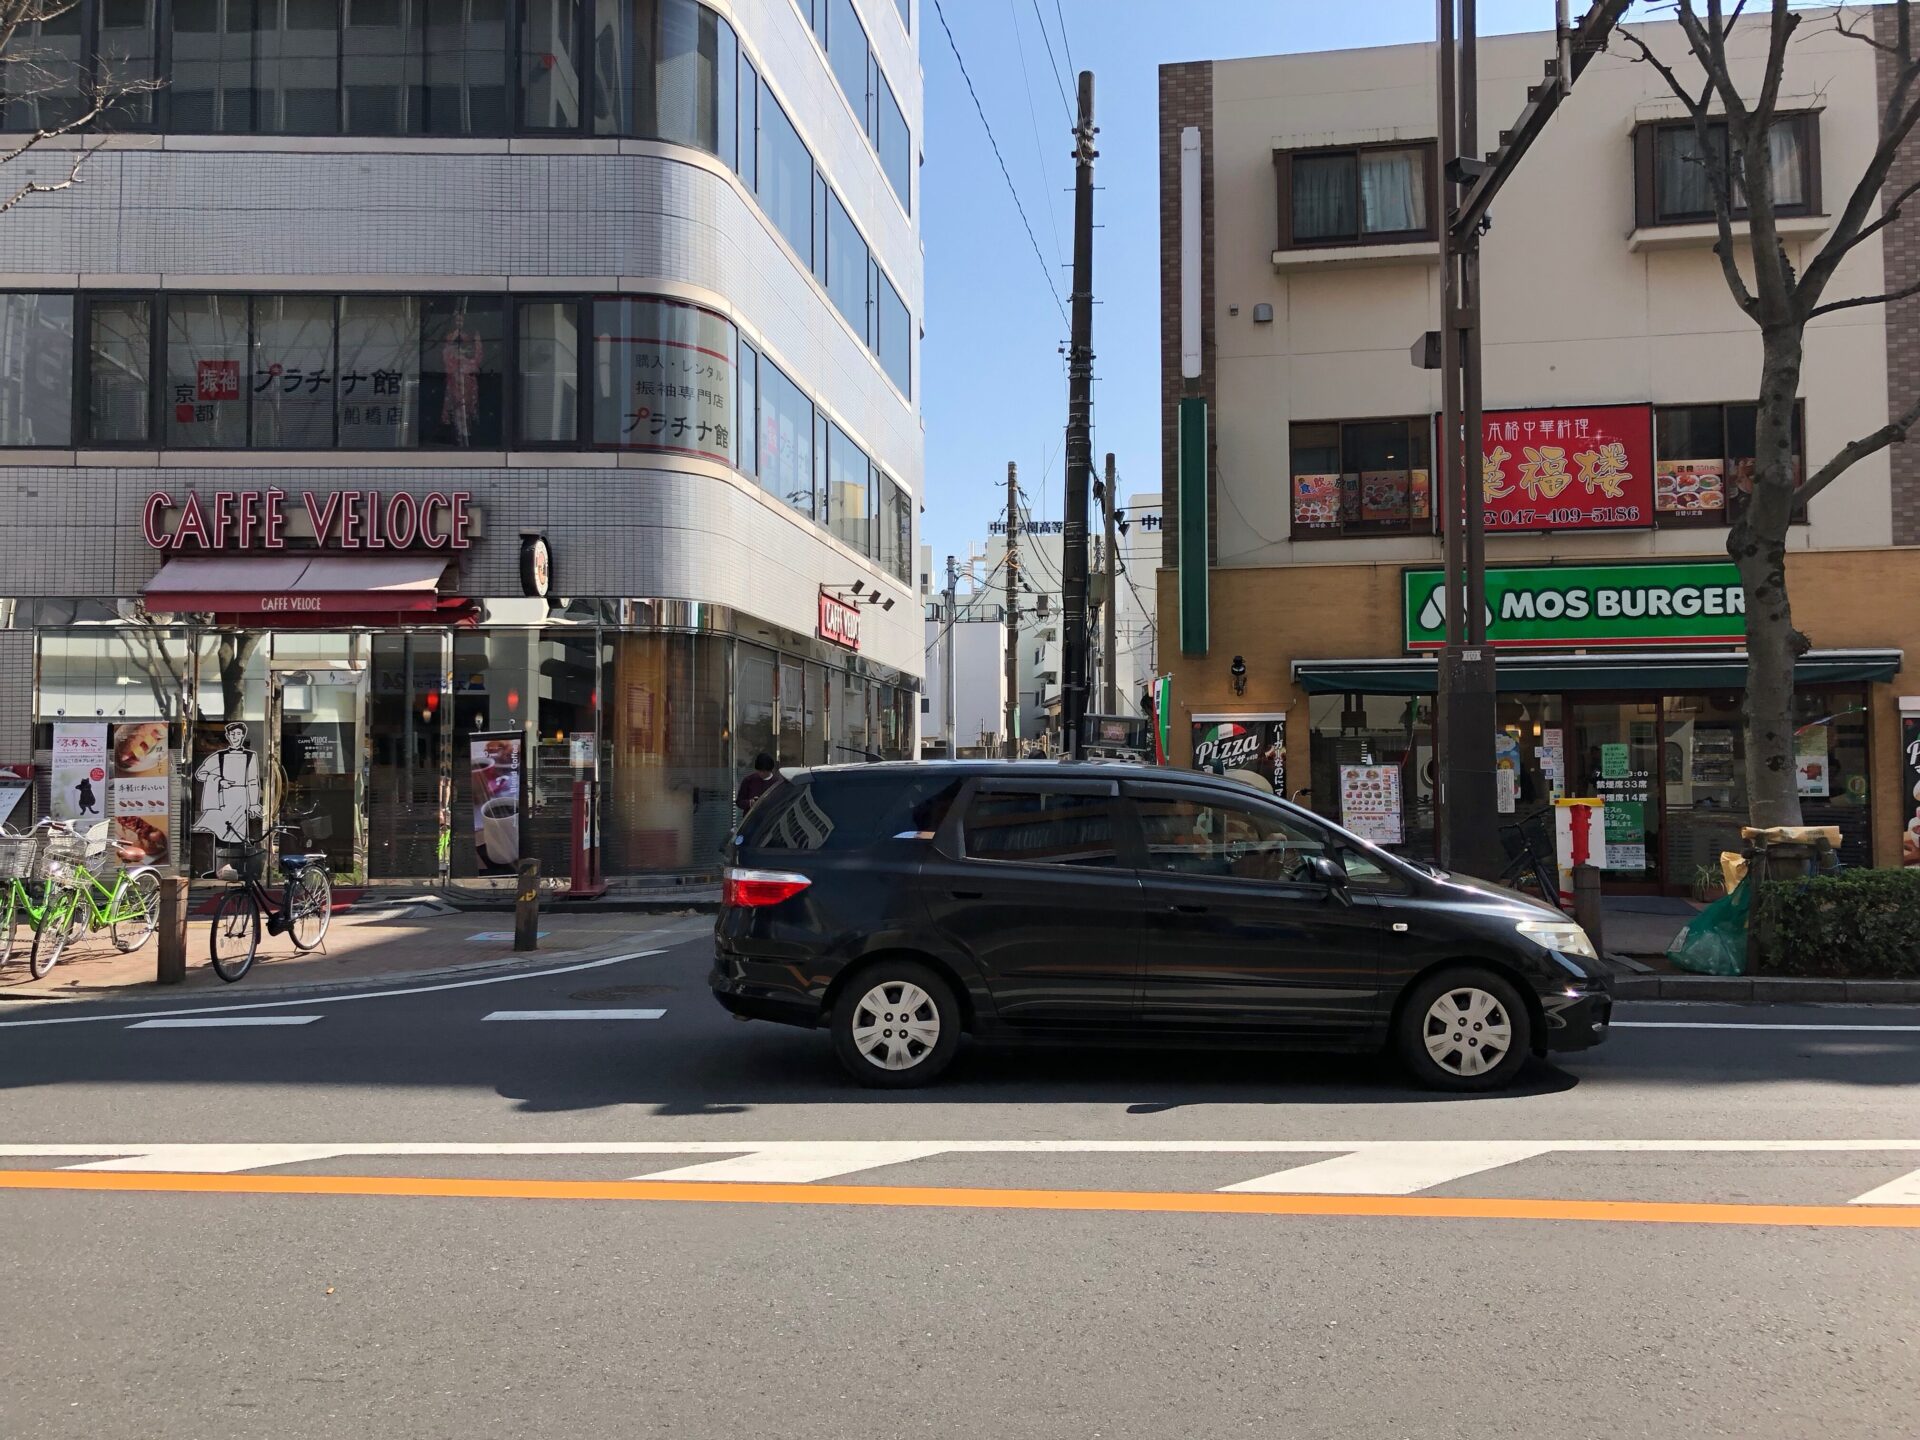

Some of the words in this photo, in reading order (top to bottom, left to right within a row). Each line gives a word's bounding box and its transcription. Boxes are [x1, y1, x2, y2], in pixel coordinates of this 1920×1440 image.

[200, 368, 238, 393] 振袖
[254, 363, 403, 395] プラチナ館
[635, 354, 724, 382] 購入・レンタル
[635, 381, 724, 409] 振袖専門店
[343, 406, 403, 426] 船橋店
[623, 407, 729, 449] プラチナ館
[1488, 418, 1589, 442] 本格中華料理
[142, 484, 288, 550] CAFFÈ
[302, 491, 471, 550] VELOCE
[1501, 507, 1640, 525] 047-409-5186
[290, 597, 321, 611] VELOCE
[1501, 590, 1589, 619] MOS
[1597, 587, 1745, 617] BURGER
[1195, 734, 1260, 765] Pizza
[1596, 780, 1648, 789] 禁煙席33席
